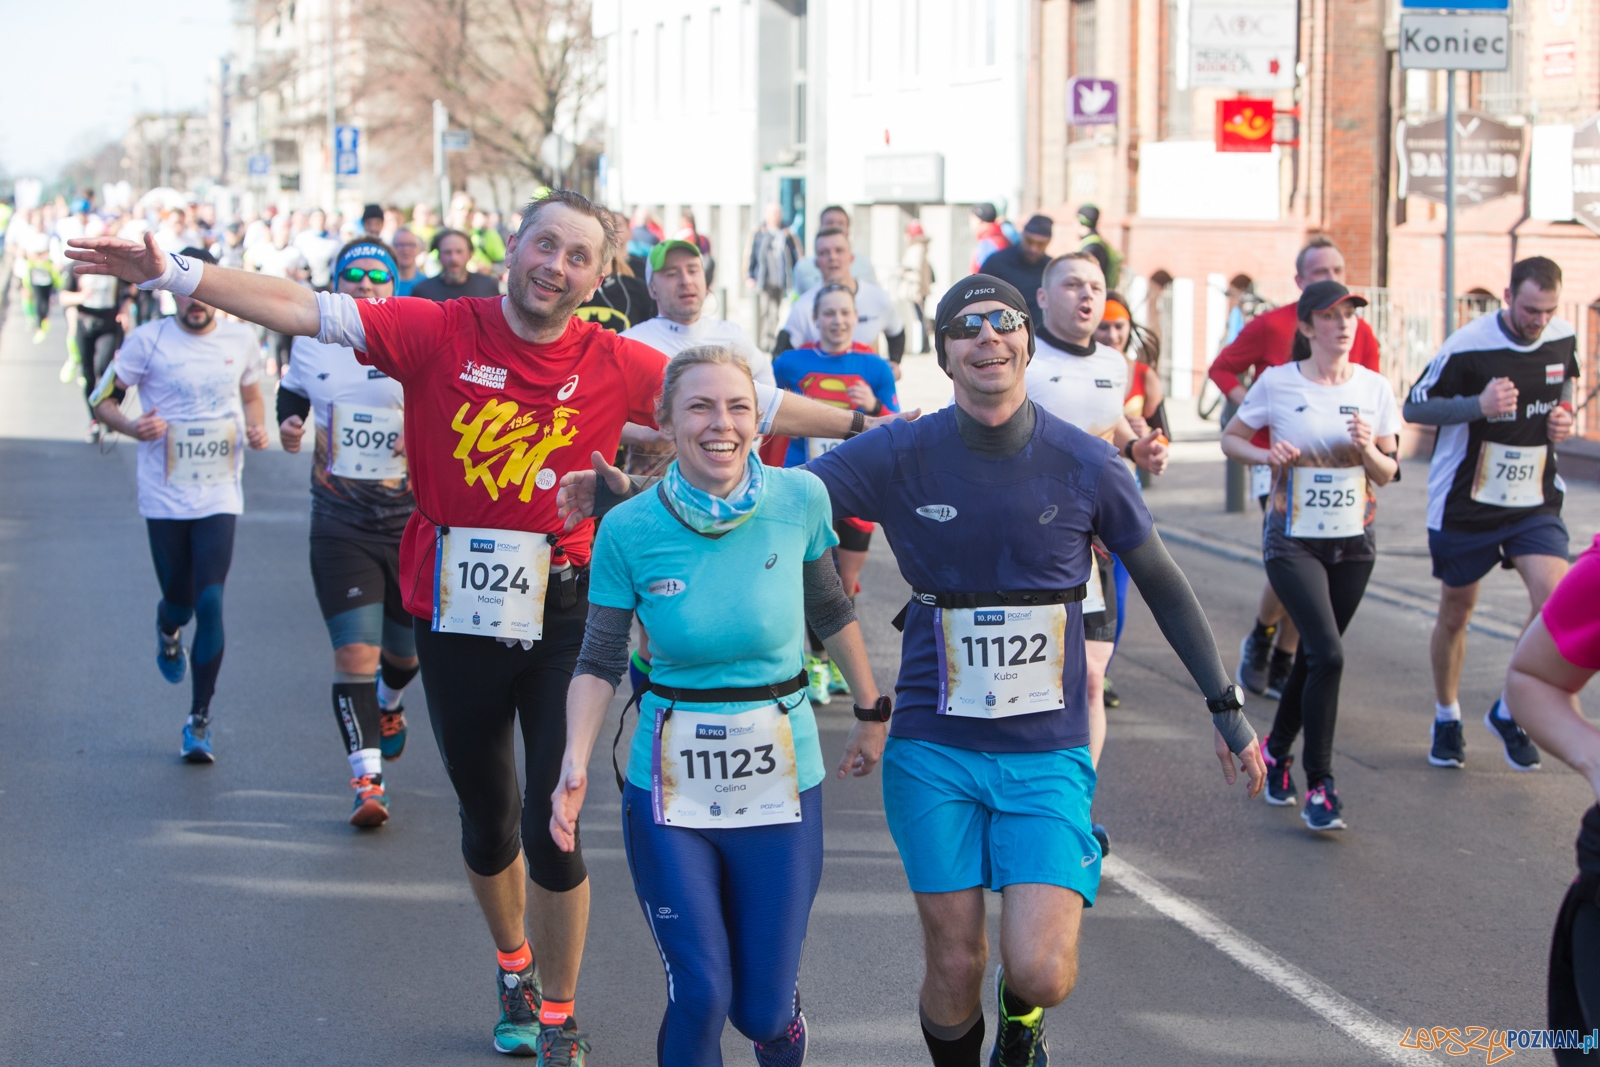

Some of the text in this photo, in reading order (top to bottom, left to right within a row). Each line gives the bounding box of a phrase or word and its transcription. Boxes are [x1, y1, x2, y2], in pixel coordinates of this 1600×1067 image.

[1404, 27, 1505, 54] Koniec
[472, 368, 507, 383] WARSAW
[480, 364, 508, 376] ORLEN
[459, 372, 506, 390] MARATHON
[342, 427, 399, 450] 3098
[176, 440, 229, 459] 11498
[1496, 462, 1535, 481] 7851
[1305, 488, 1356, 508] 2525
[479, 542, 493, 550] PKO
[458, 561, 530, 595] 1024
[477, 594, 505, 606] Maciej
[986, 614, 1003, 622] PKO
[961, 633, 1048, 667] 11122
[993, 672, 1018, 681] Kuba
[680, 744, 776, 780] 11123
[714, 783, 746, 793] Celina
